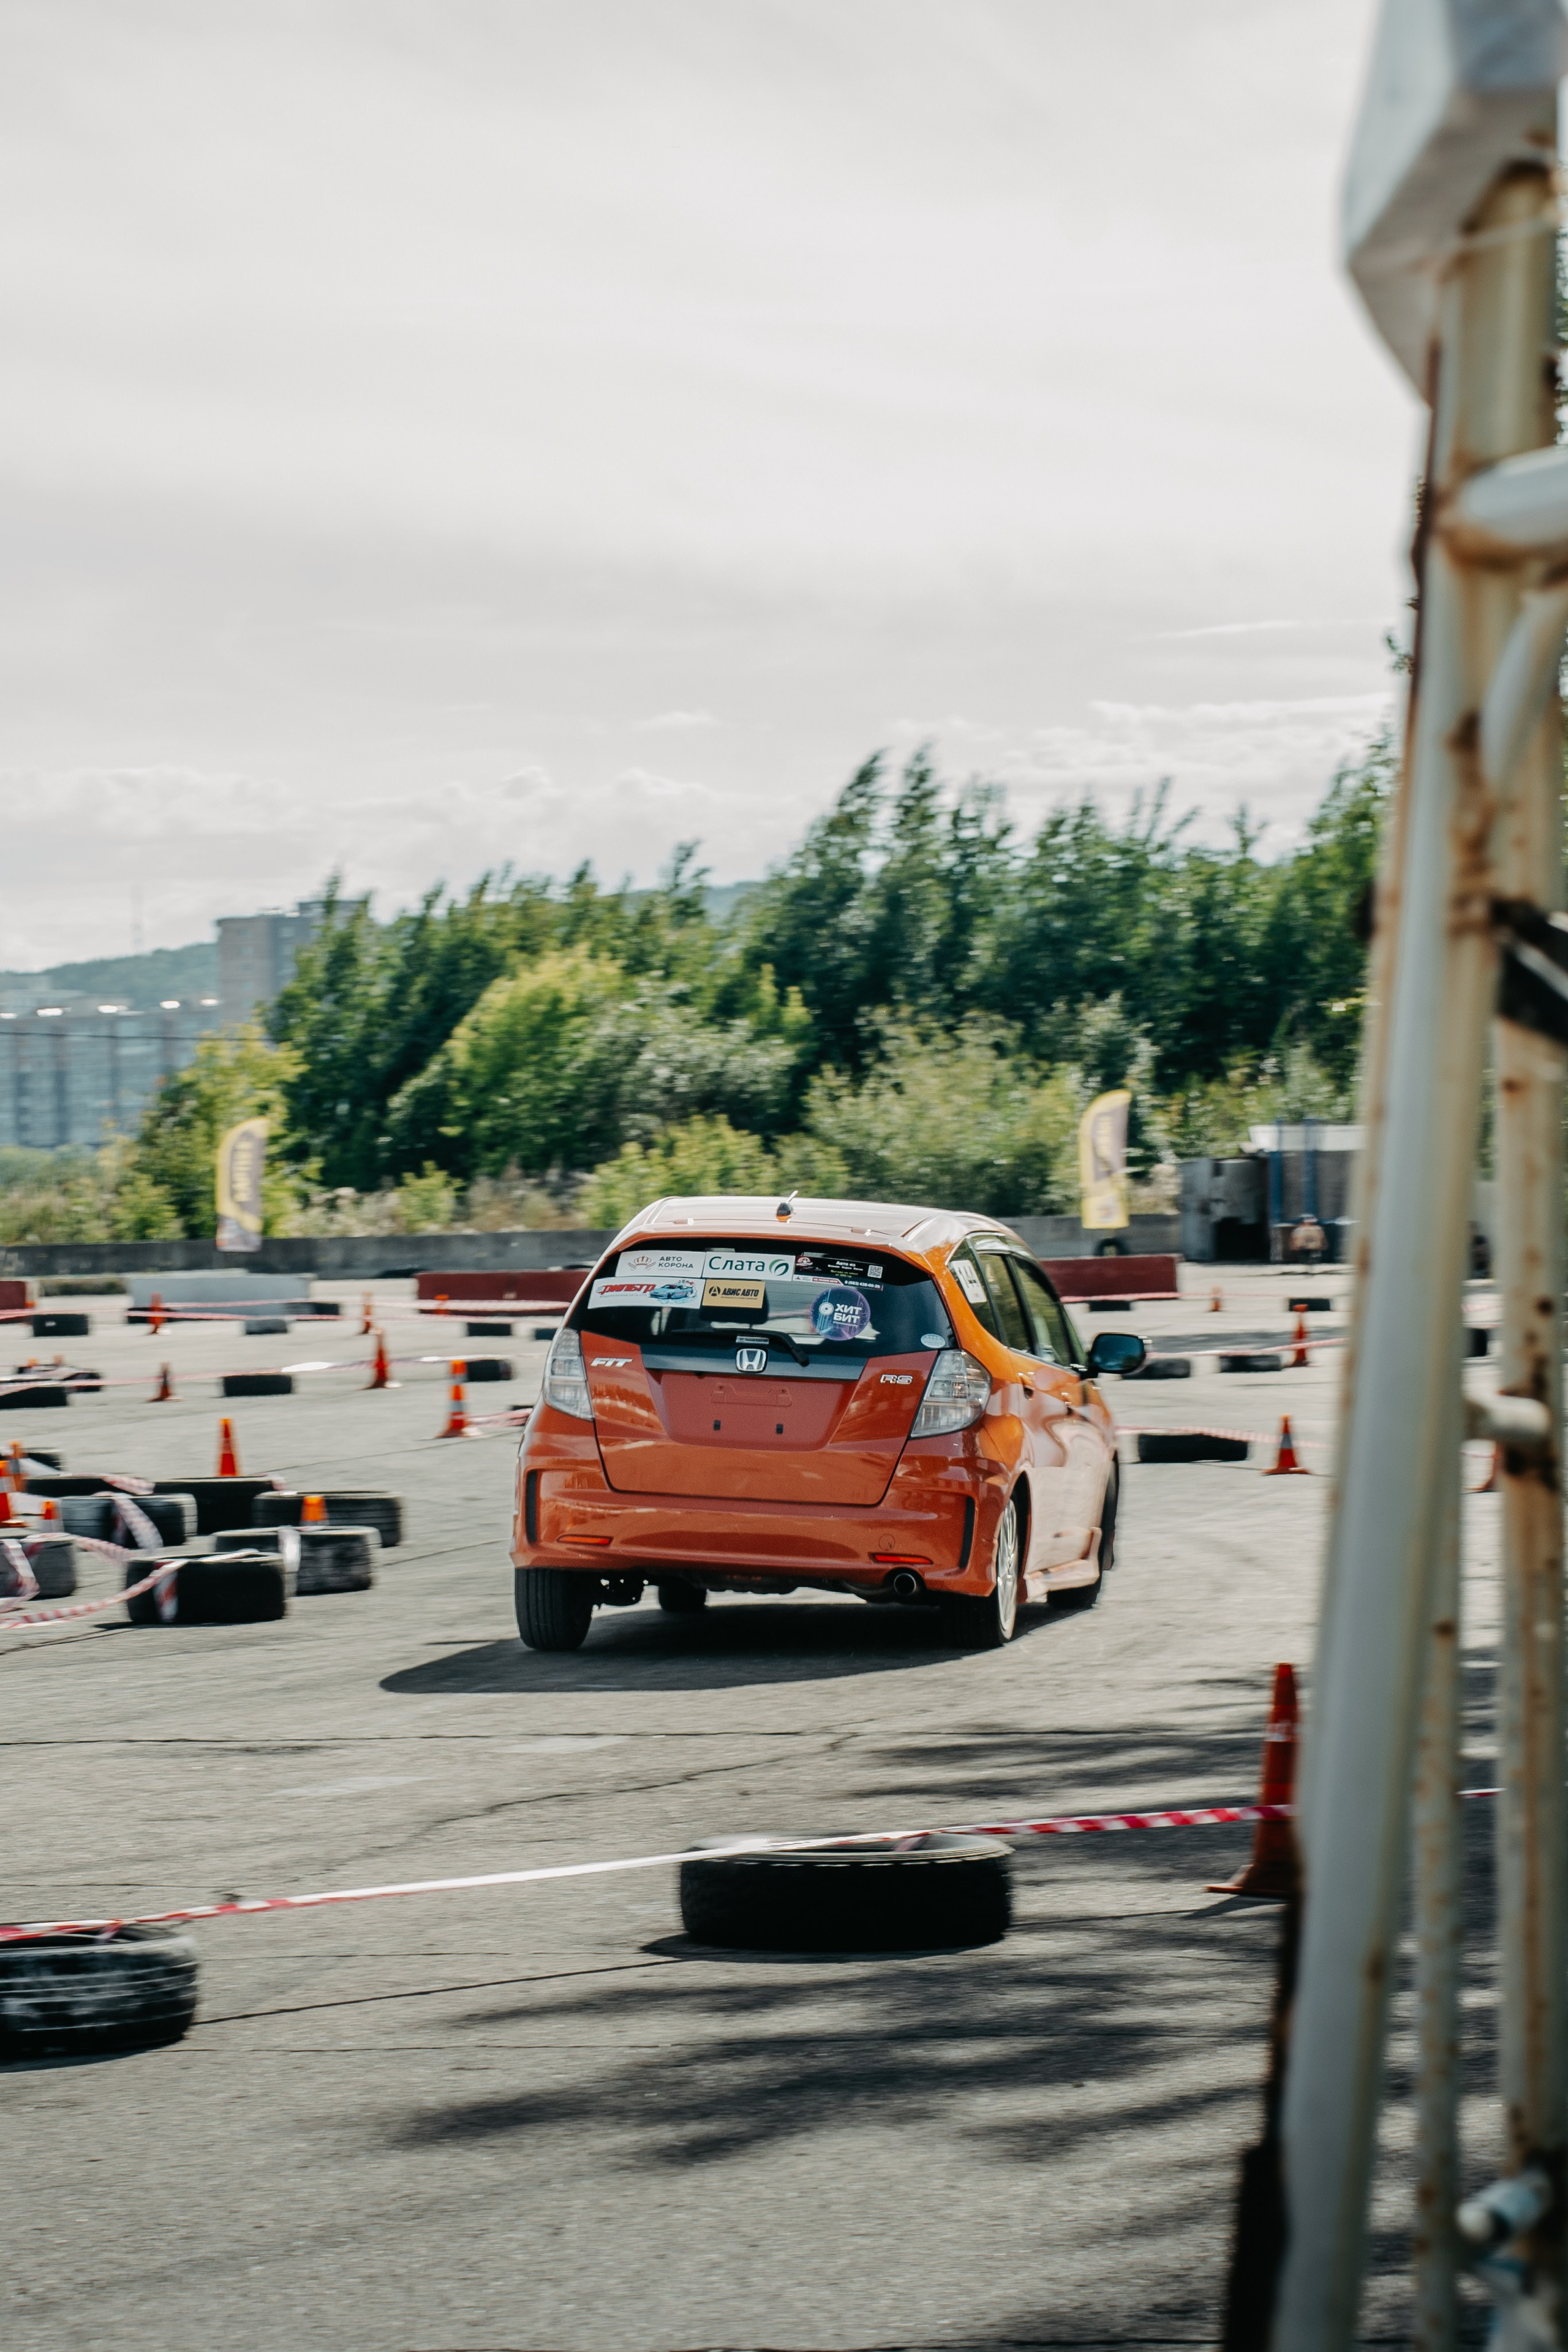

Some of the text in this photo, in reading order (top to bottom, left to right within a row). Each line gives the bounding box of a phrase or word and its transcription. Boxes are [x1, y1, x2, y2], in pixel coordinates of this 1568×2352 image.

[709, 1256, 765, 1272] Слата
[834, 1303, 862, 1315] ХИТ
[833, 1312, 860, 1324] БИТ
[590, 1357, 633, 1367] FIT
[880, 1374, 913, 1385] RS
